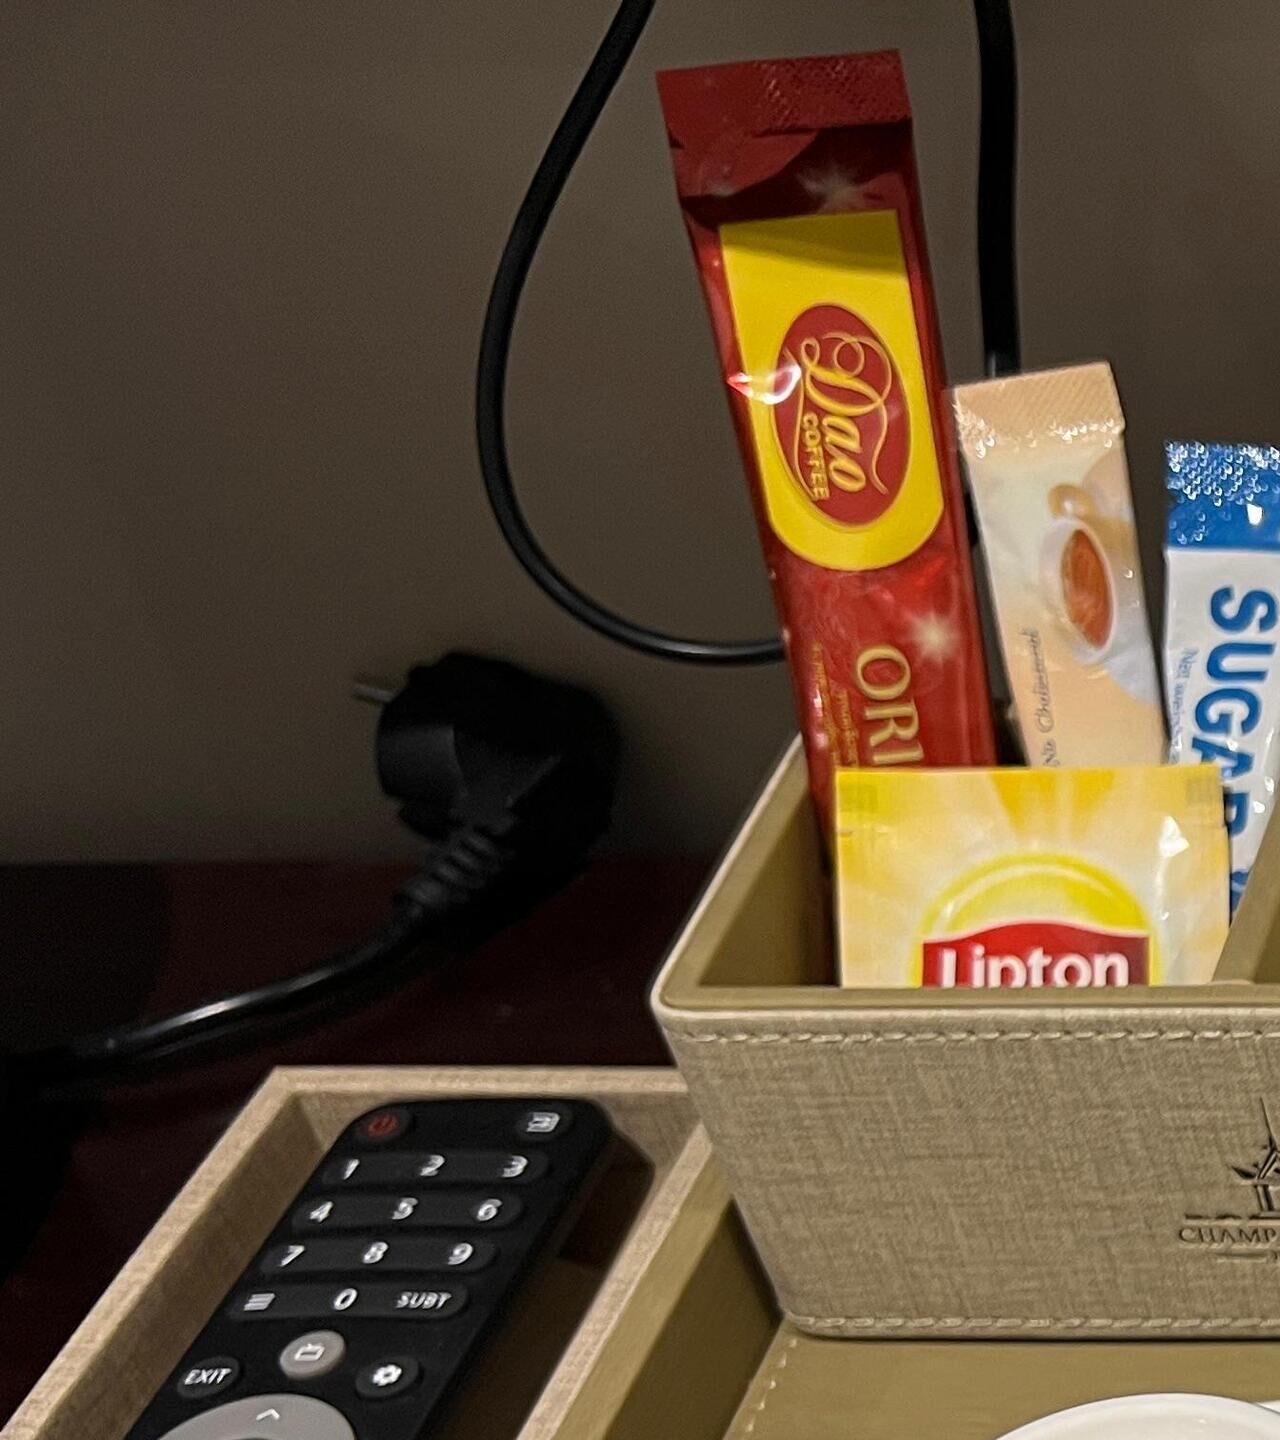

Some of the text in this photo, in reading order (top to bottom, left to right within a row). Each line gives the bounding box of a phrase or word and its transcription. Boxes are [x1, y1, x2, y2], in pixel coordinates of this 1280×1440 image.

[803, 412, 830, 500] COFFEE
[342, 1154, 529, 1181] 1 2 3
[308, 1197, 503, 1223] 4 5 6
[279, 1241, 474, 1268] 7 8 9
[332, 1287, 358, 1311] 0
[183, 1367, 232, 1385] EXIT
